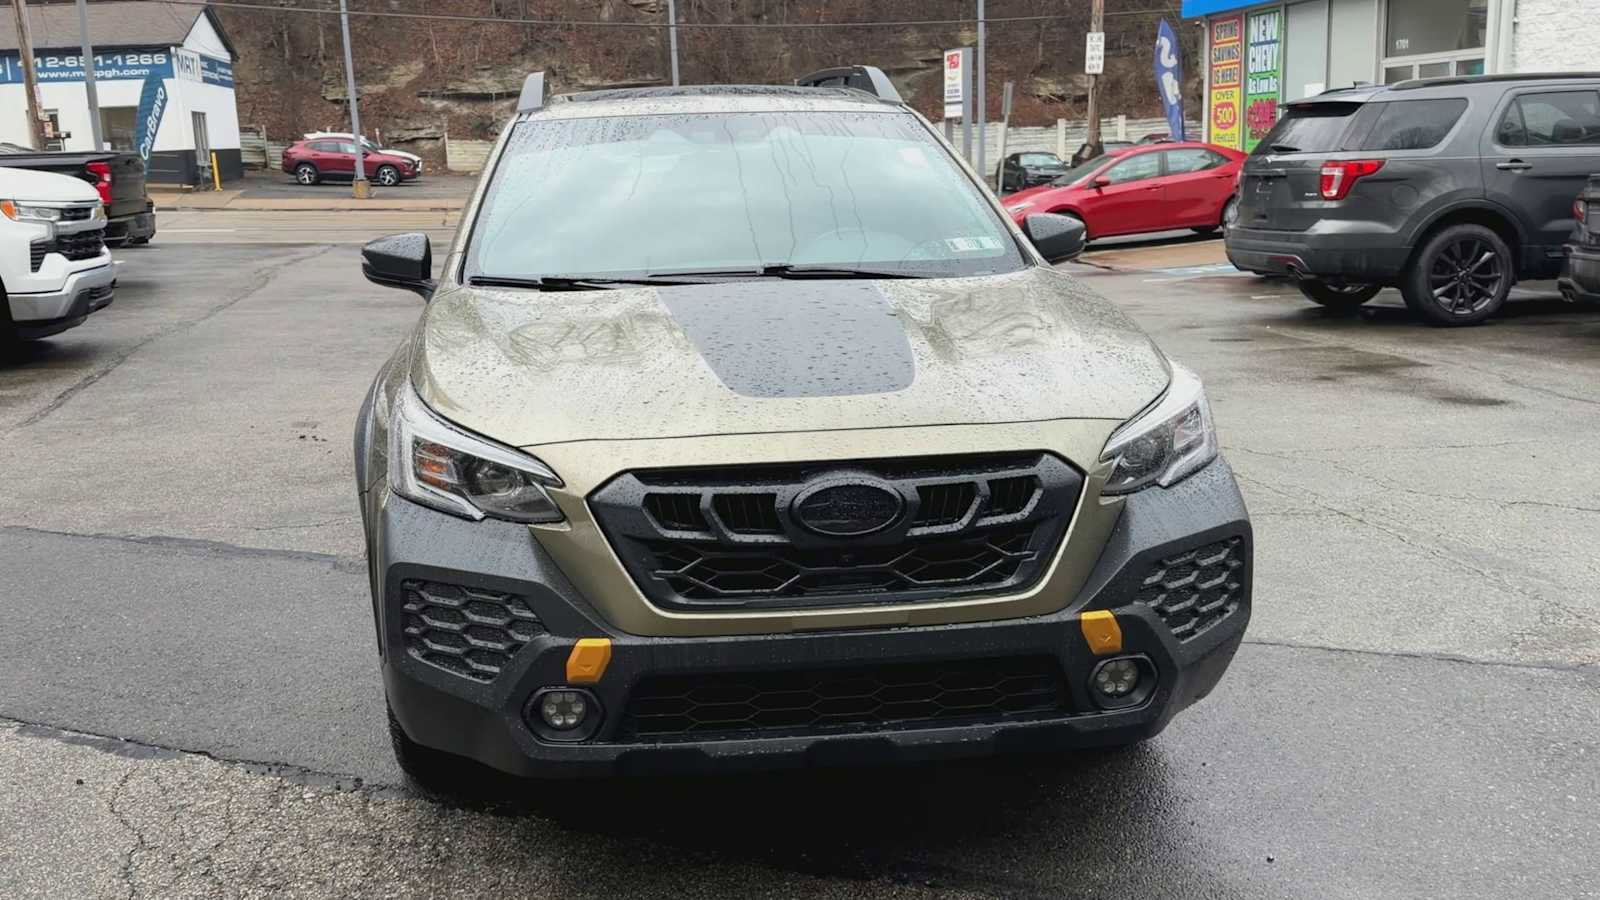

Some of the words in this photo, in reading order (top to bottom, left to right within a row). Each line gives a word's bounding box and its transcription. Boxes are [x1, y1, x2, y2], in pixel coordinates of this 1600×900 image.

[1250, 11, 1280, 43] NEW
[17, 54, 167, 68] 12-61-1266
[37, 68, 150, 78] www.mpgh.com
[1249, 44, 1280, 73] CHEVY
[140, 87, 165, 160] CarBravo
